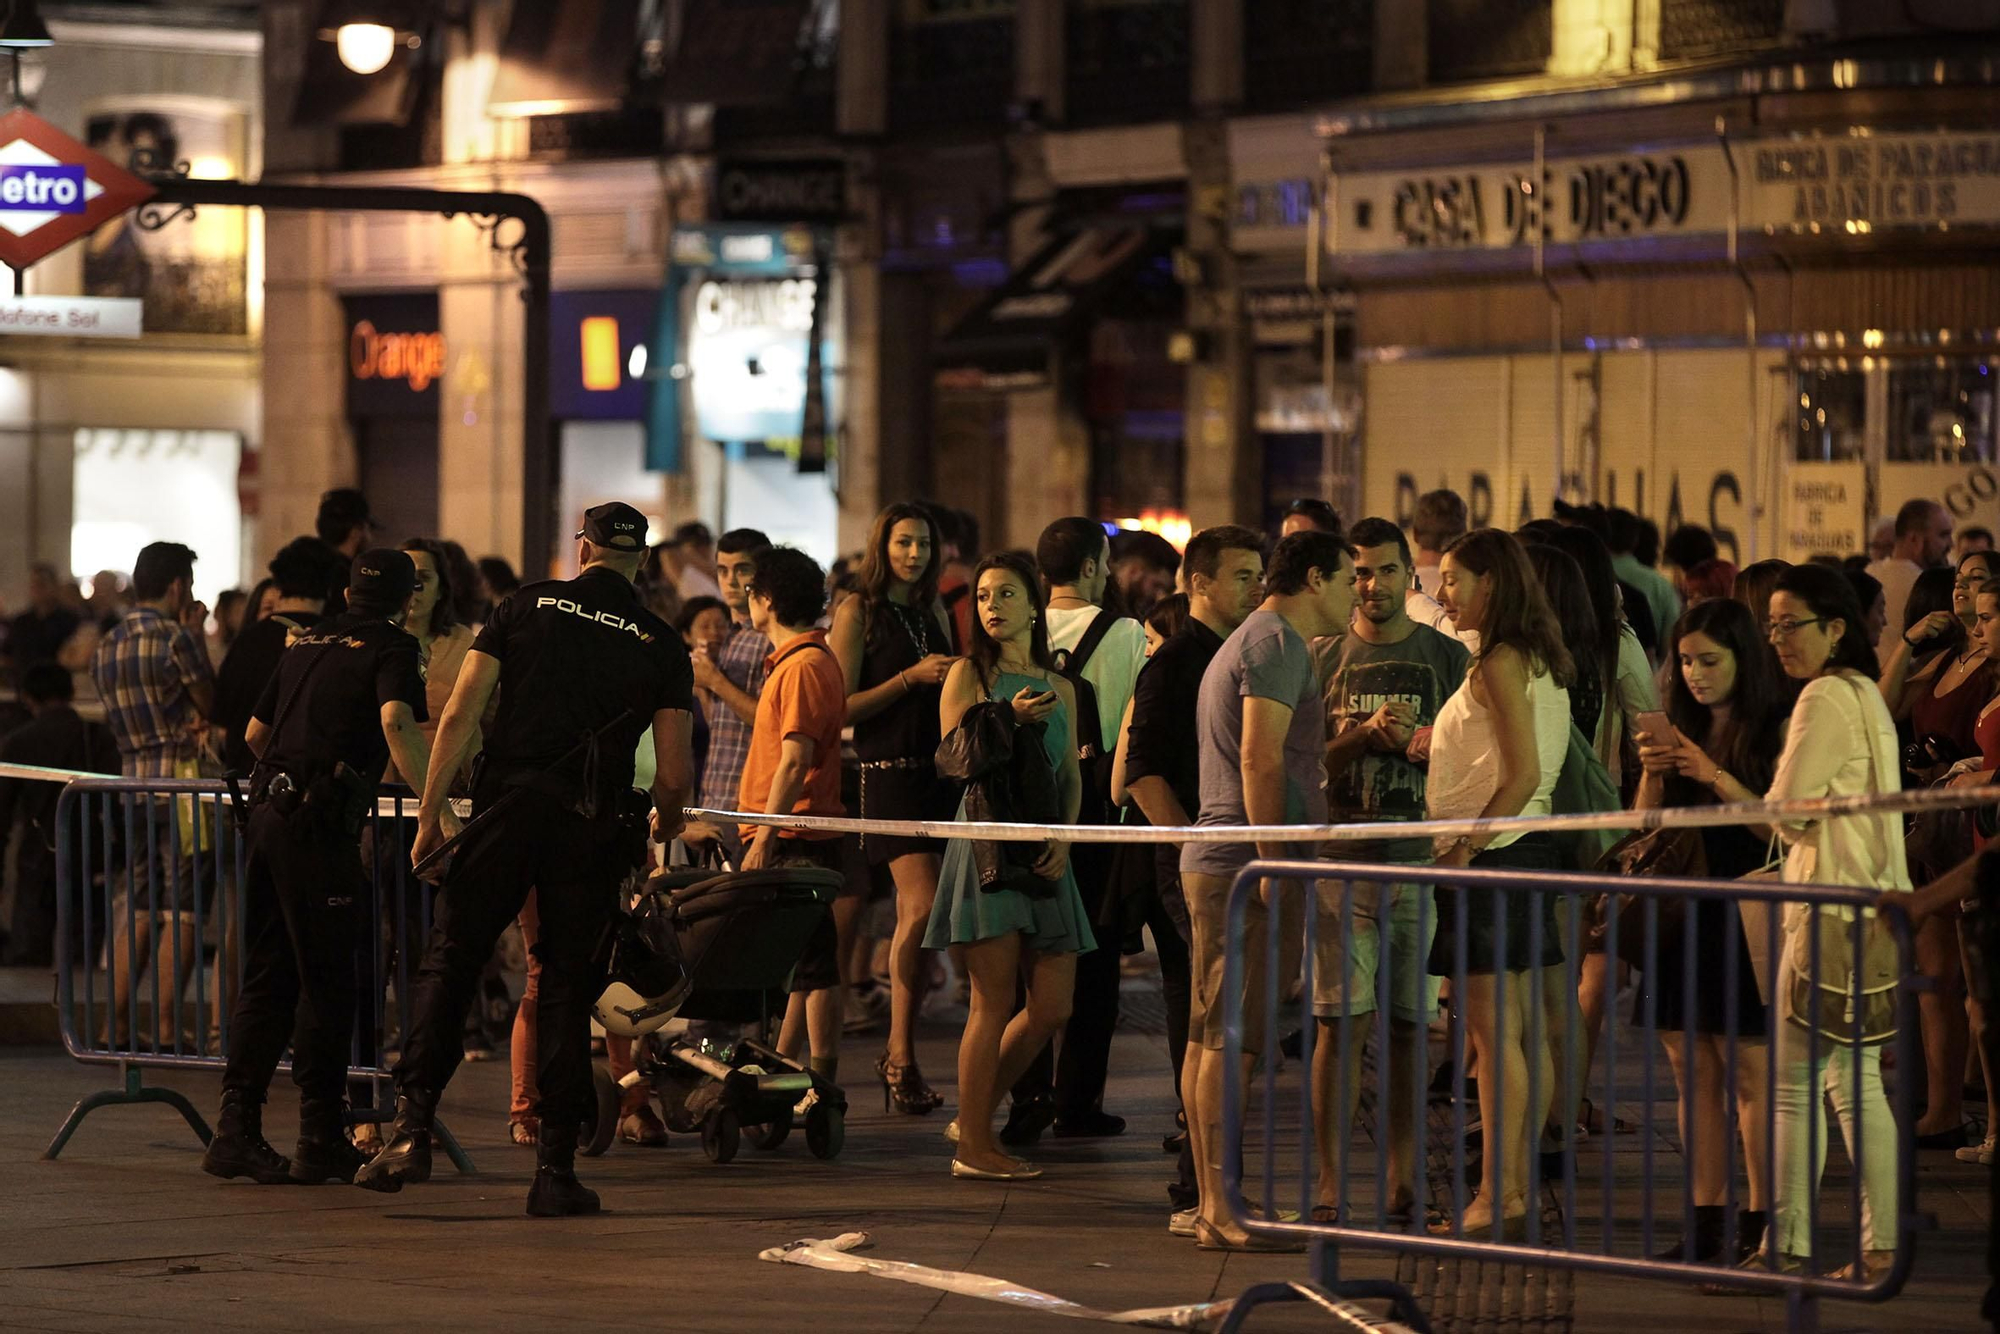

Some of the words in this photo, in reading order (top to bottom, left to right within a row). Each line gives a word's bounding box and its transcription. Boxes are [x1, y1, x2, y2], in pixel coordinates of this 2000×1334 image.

[0, 170, 78, 205] etro
[1394, 175, 1488, 245] CASA
[1505, 168, 1552, 245] DE
[1571, 157, 1690, 236] DIEGO
[350, 319, 447, 392] Orange
[614, 522, 635, 531] CNP
[361, 567, 381, 577] CNP
[536, 596, 640, 637] POLICIA
